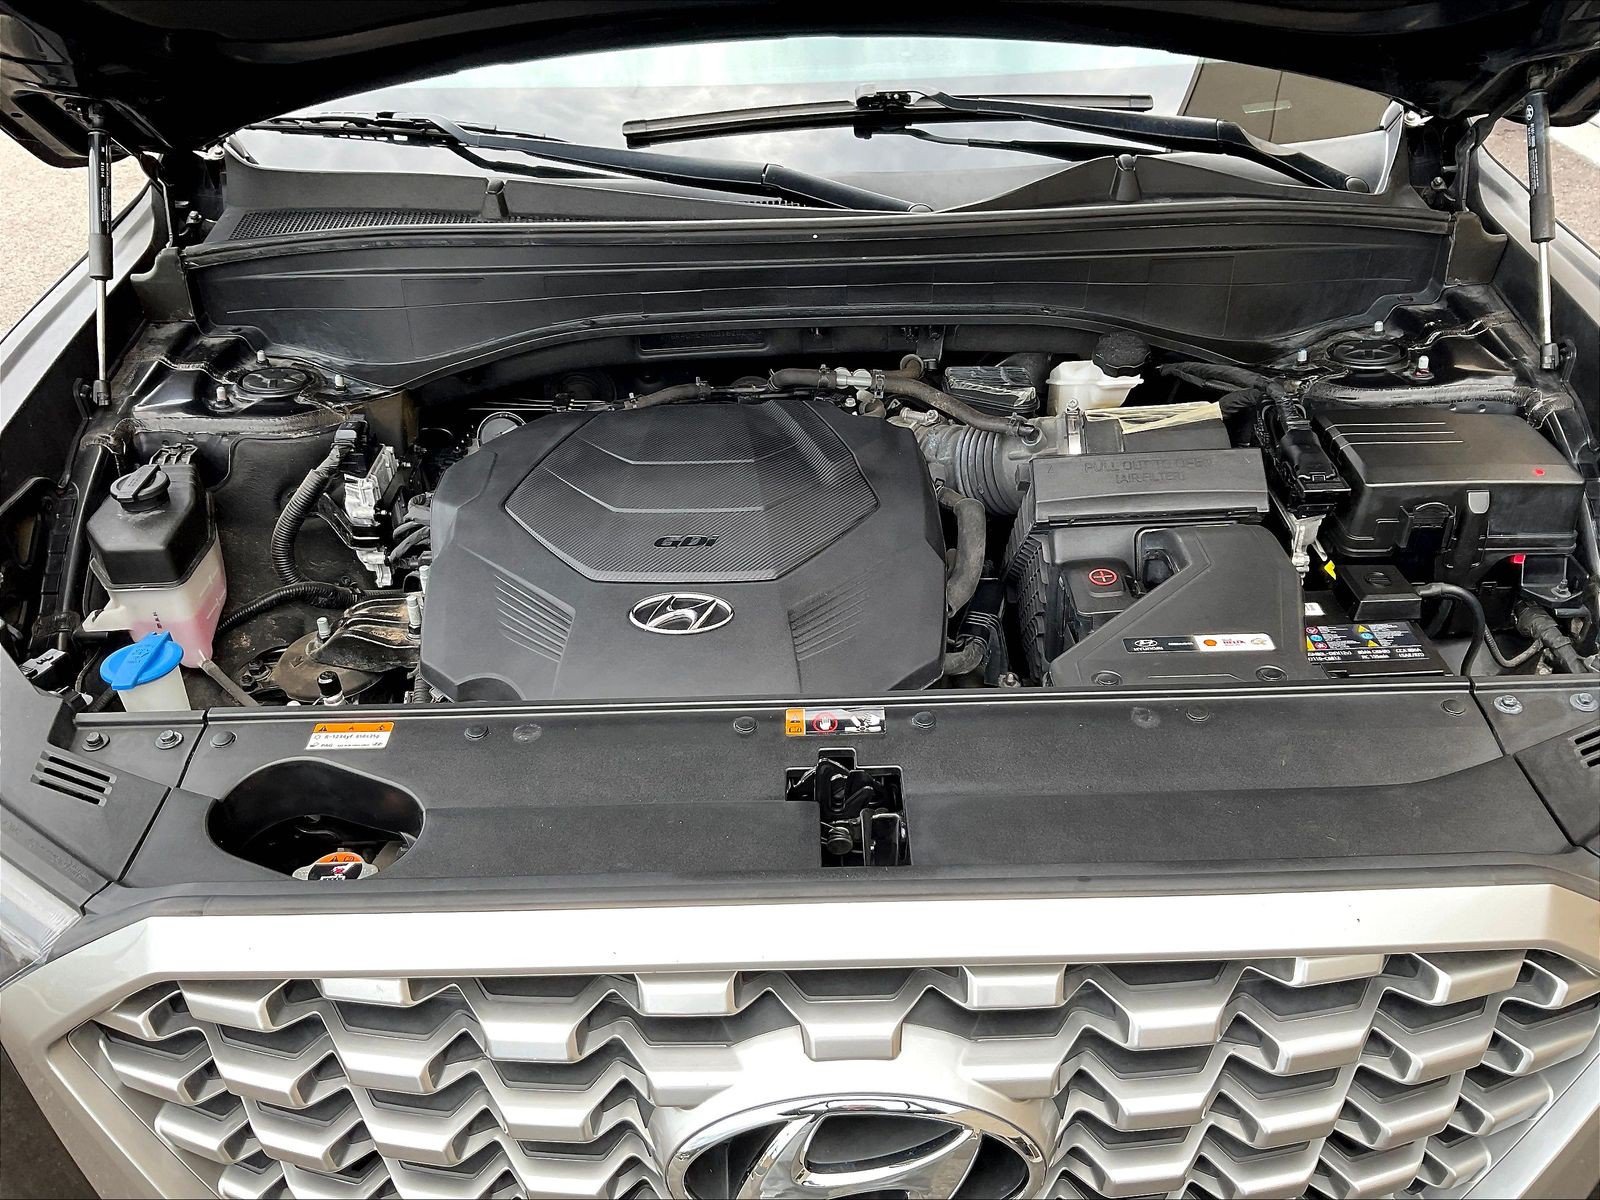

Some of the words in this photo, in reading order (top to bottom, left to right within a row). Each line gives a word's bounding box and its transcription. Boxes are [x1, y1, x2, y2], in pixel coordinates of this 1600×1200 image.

[1084, 460, 1120, 473] PULL
[1123, 459, 1151, 470] OUT
[653, 534, 720, 548] GDi
